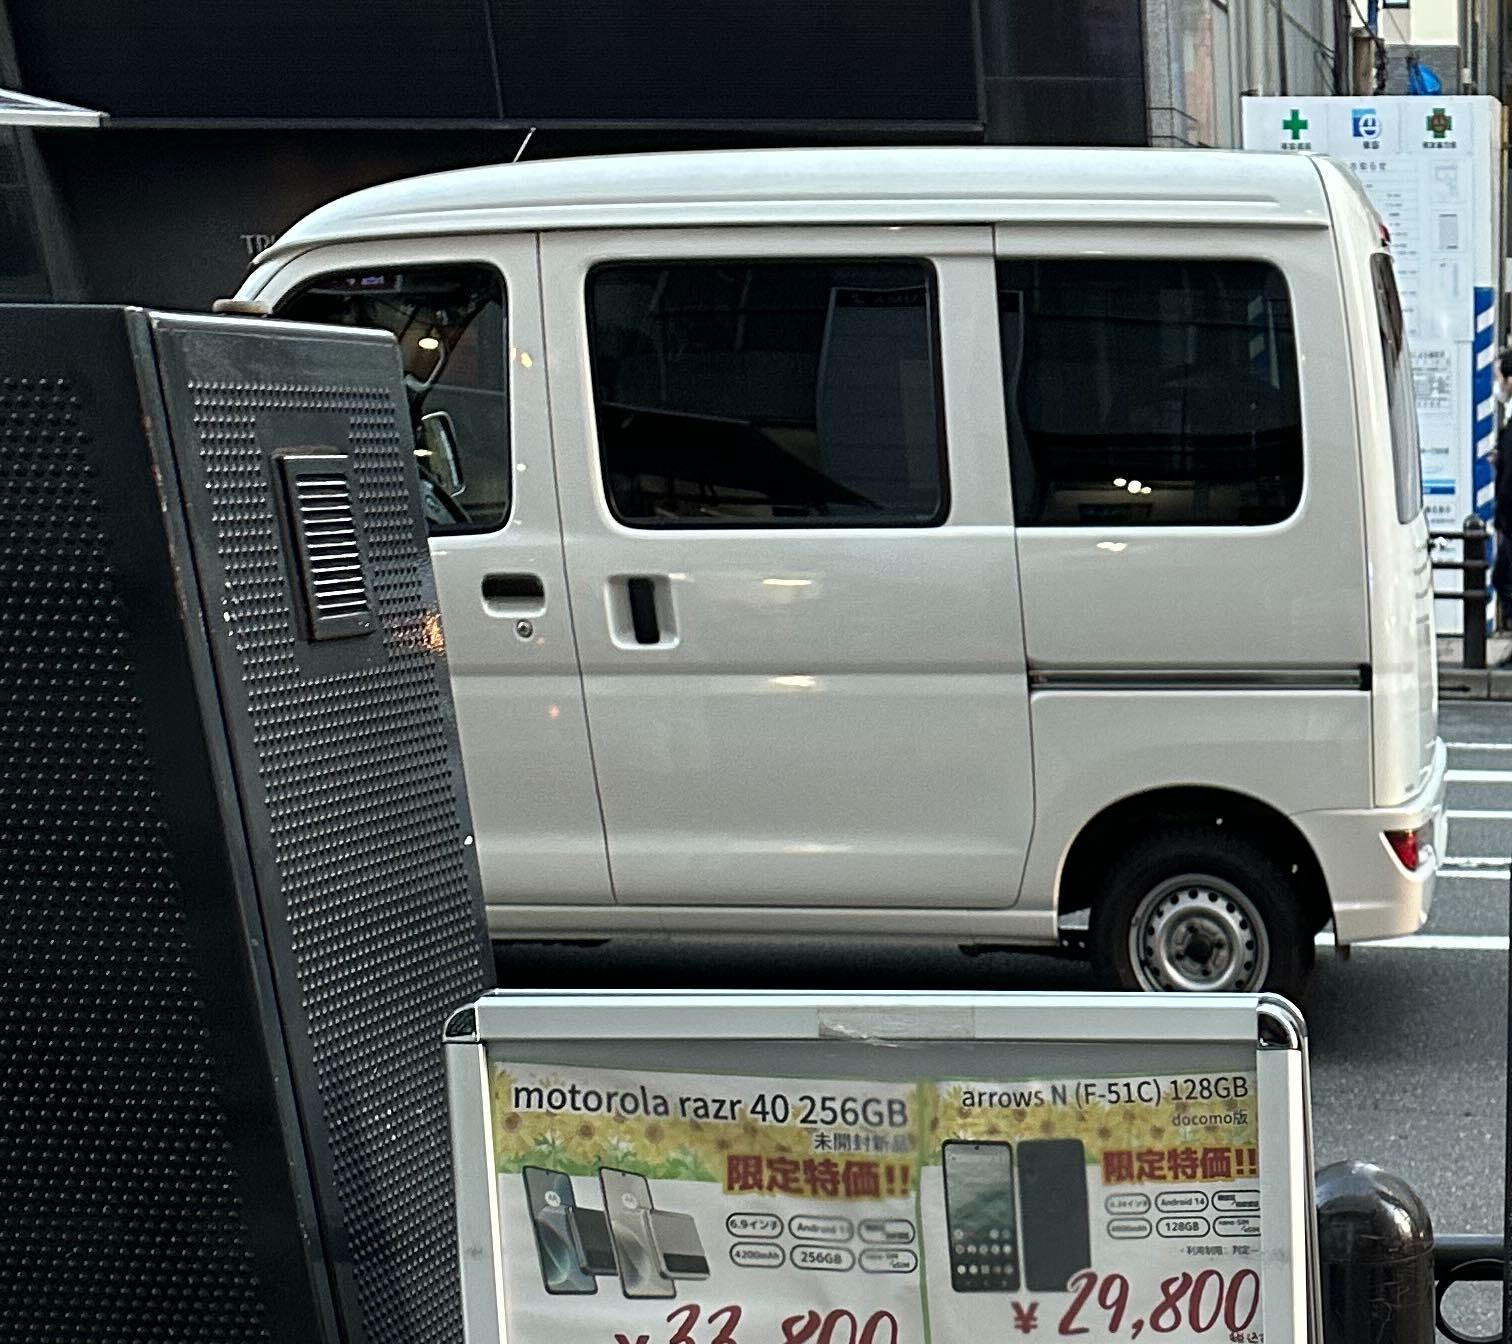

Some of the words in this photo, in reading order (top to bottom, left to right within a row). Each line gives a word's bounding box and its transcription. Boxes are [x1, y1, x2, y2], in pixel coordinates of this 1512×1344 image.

[512, 1084, 670, 1118] motorola
[678, 1096, 742, 1121] razr
[749, 1093, 790, 1125] 40
[798, 1094, 909, 1129] 256GB
[961, 1087, 1044, 1109] arrows
[1050, 1082, 1068, 1106] N
[1074, 1079, 1163, 1108] (F-51C)
[1170, 1076, 1249, 1102] 128GB
[1172, 1111, 1249, 1127] docomo版
[726, 1154, 912, 1196] 限定特価!!
[1103, 1147, 1257, 1181] 限定特価!!
[1165, 1222, 1200, 1232] 128GB
[1010, 1268, 1262, 1341] ¥29,800
